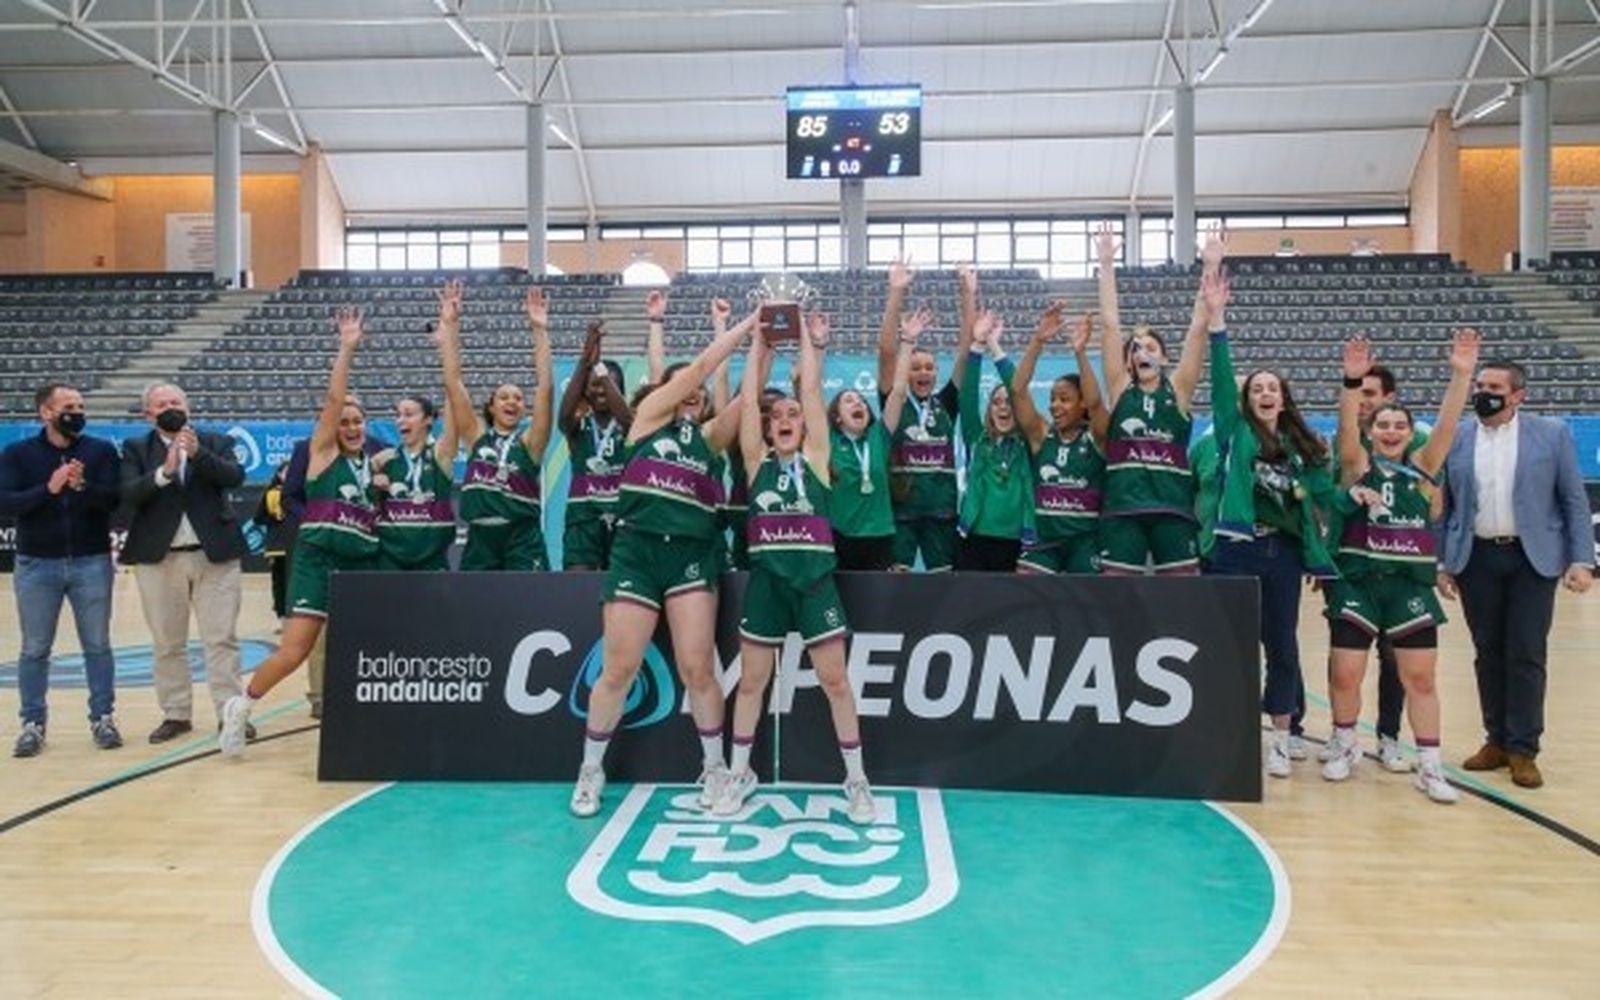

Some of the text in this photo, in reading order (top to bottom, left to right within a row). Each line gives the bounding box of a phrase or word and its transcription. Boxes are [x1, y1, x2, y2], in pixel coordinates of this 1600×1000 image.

[797, 115, 828, 138] 85
[878, 112, 910, 135] 53
[358, 650, 492, 678] baloncesto
